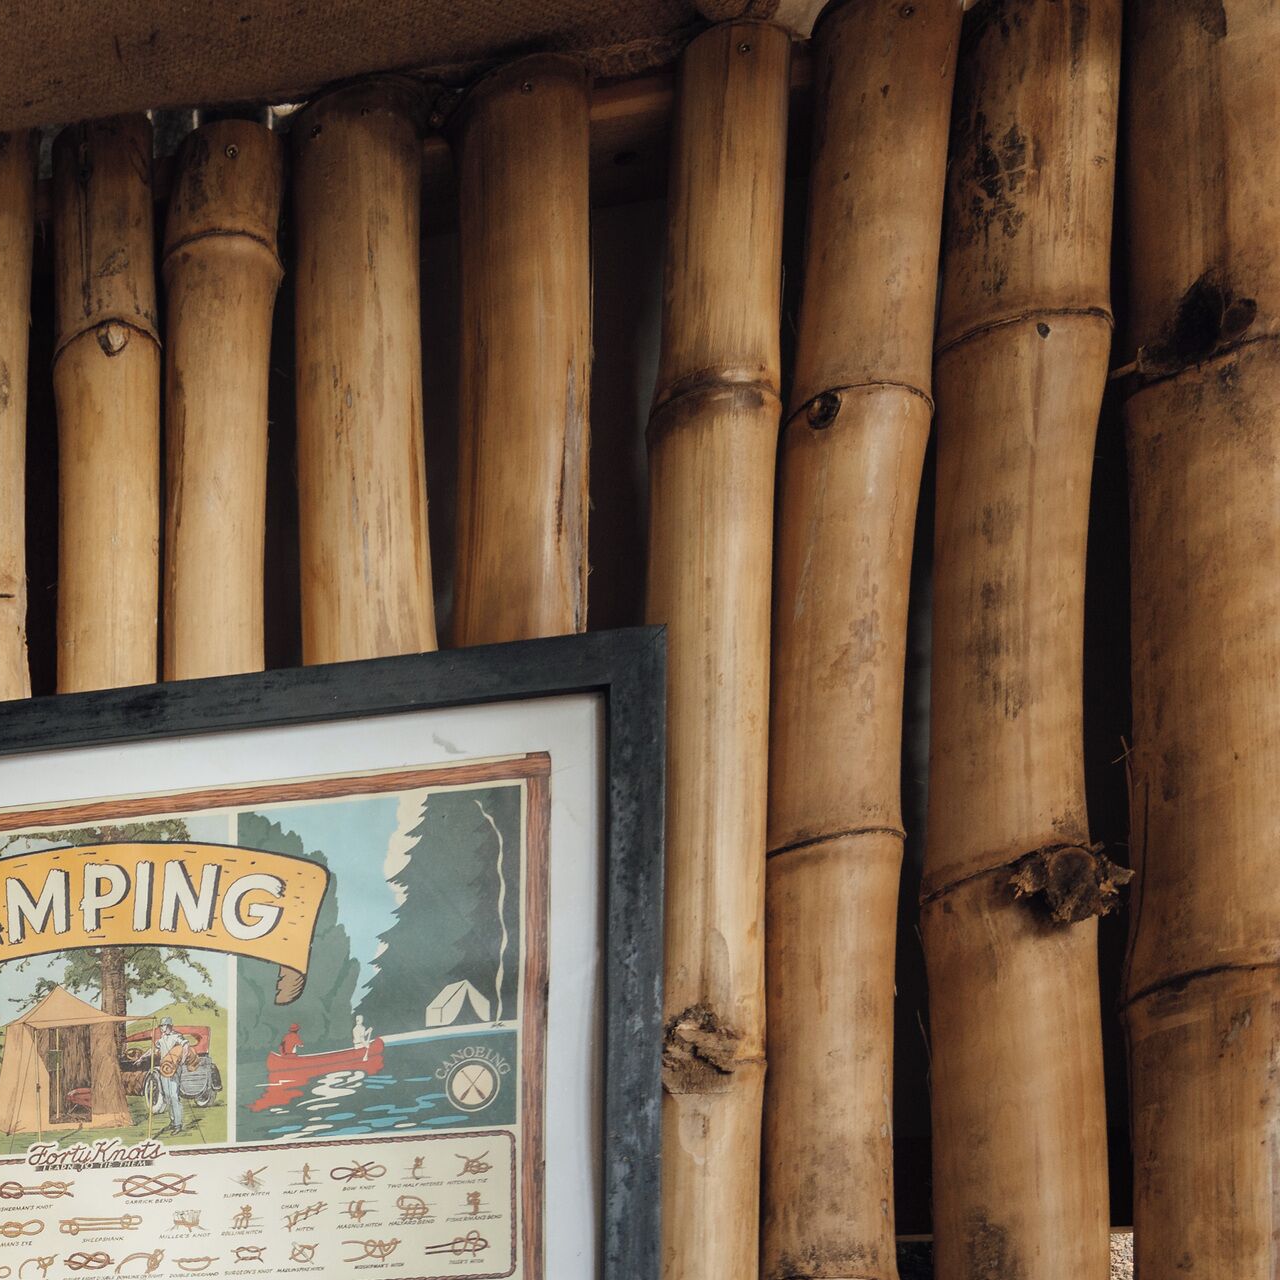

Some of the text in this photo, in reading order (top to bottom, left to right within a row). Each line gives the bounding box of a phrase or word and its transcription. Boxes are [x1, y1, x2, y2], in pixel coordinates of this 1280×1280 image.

[435, 1046, 511, 1080] CANOEING
[28, 1140, 166, 1172] Forty Knots
[43, 1164, 73, 1172] LEARN
[100, 1161, 113, 1169] TIE
